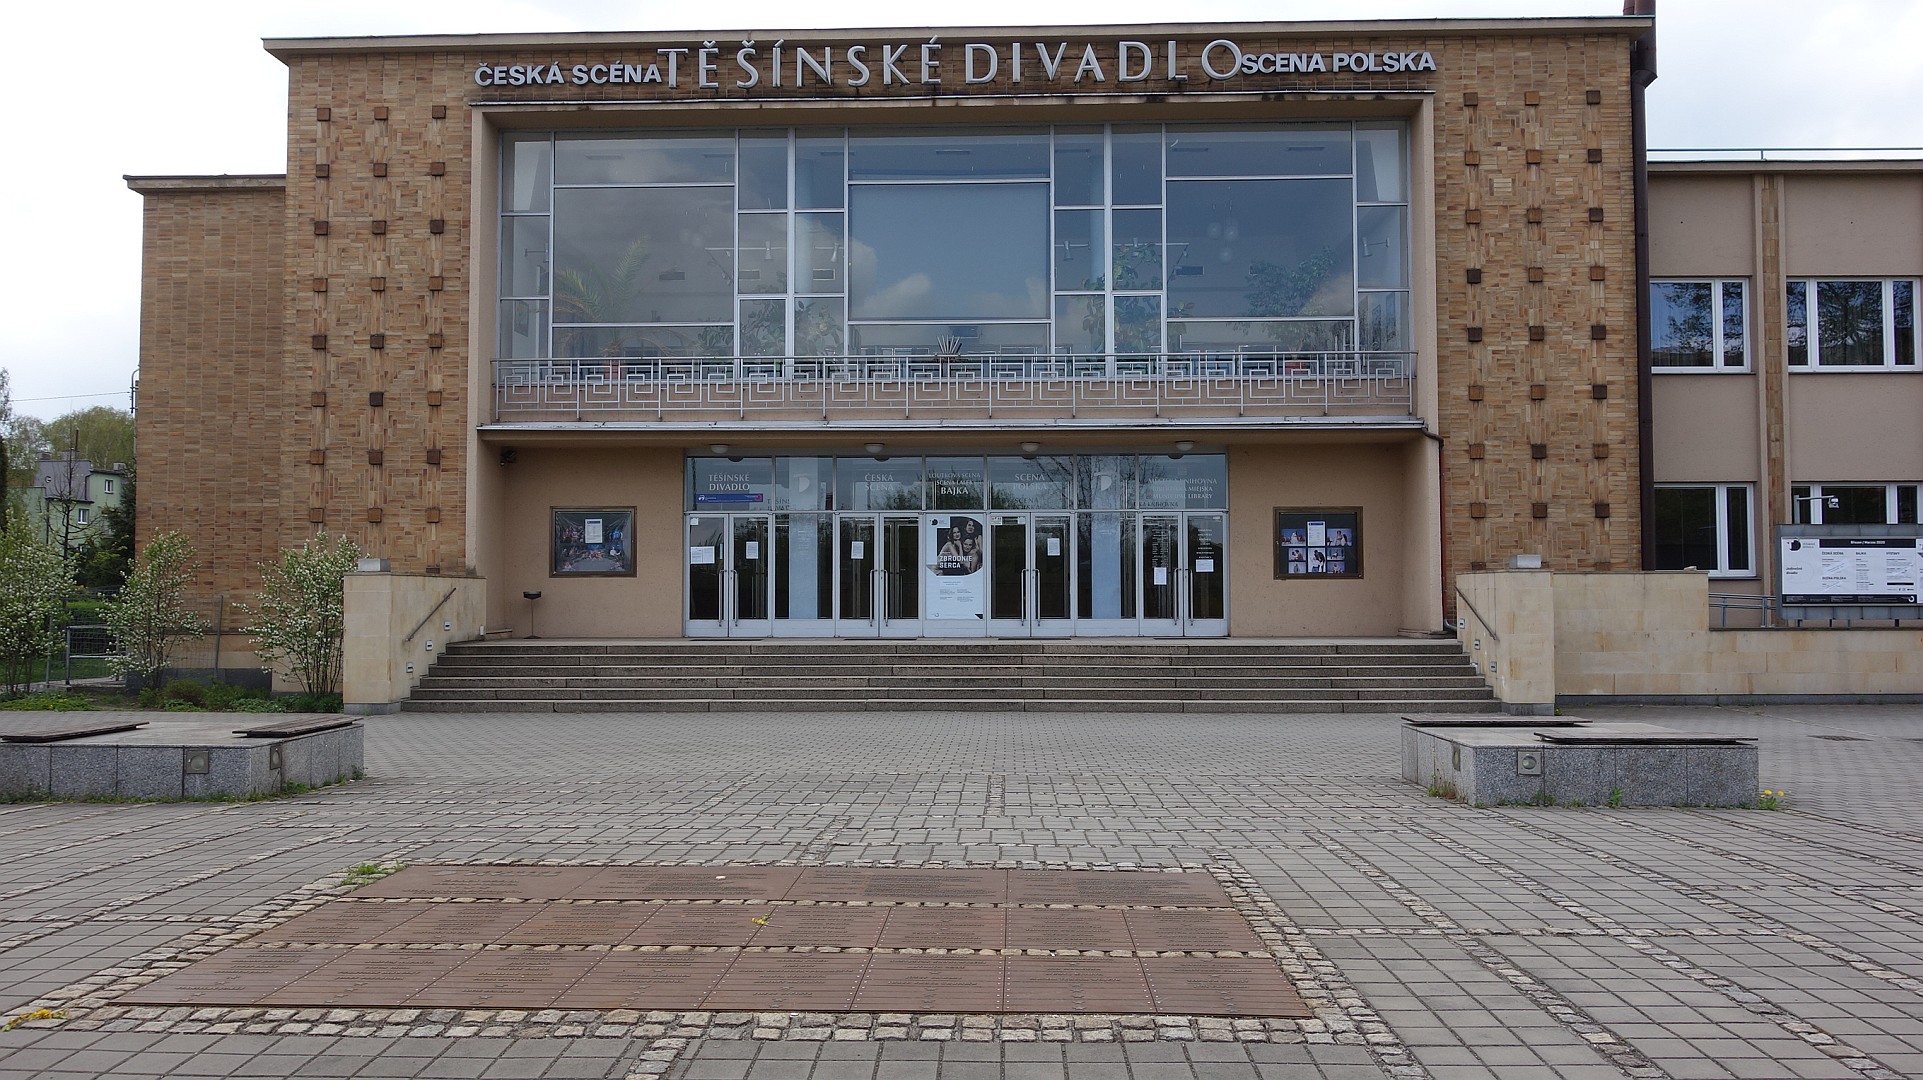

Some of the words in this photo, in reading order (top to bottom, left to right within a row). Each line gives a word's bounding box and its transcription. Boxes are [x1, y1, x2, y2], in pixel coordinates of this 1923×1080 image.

[657, 35, 942, 89] TĚŠÍNSKÉ
[964, 38, 1242, 84] DIVADLO
[1240, 52, 1327, 75] SCENA
[1333, 52, 1437, 74] POLSKA
[475, 62, 565, 87] ČESKÁ
[571, 60, 662, 84] SCÉNA
[1014, 473, 1045, 481] SCENA
[709, 483, 750, 491] DIVADLO
[940, 487, 969, 496] BAJKA
